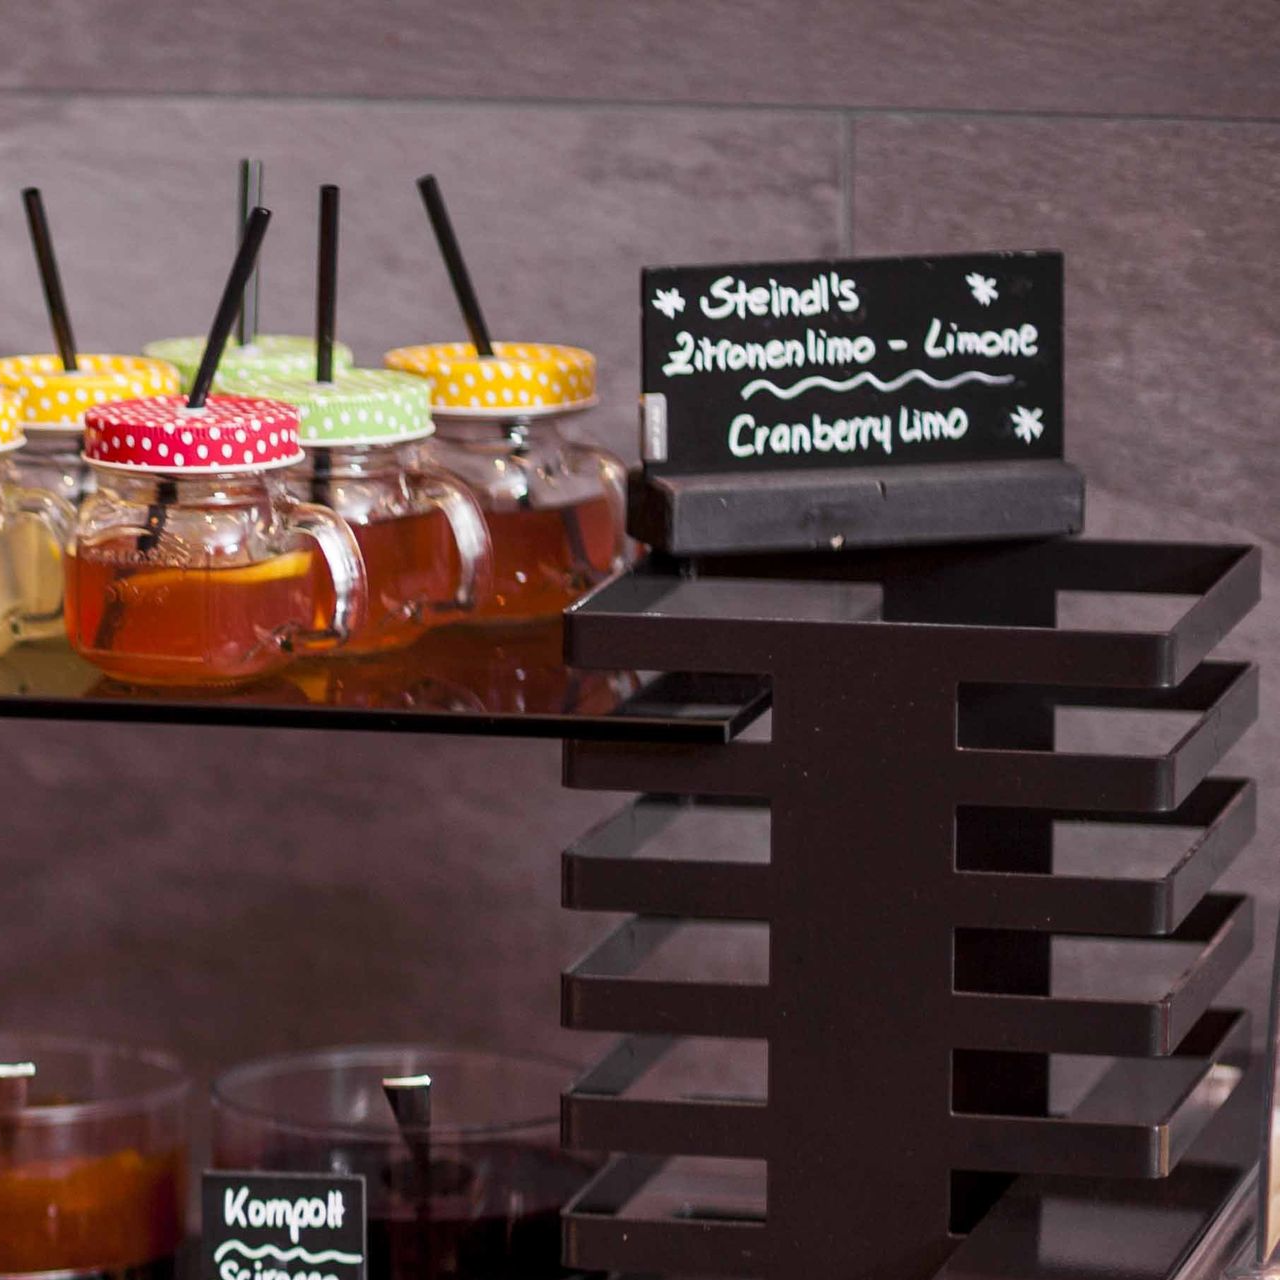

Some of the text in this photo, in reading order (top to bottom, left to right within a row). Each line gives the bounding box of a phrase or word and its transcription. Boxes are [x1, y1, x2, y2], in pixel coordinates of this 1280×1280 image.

[700, 272, 859, 319] Steindl's
[662, 329, 876, 377] Zitronenlimo
[924, 318, 1038, 358] Limone
[899, 406, 968, 444] Limo
[224, 1186, 346, 1244] Kompott
